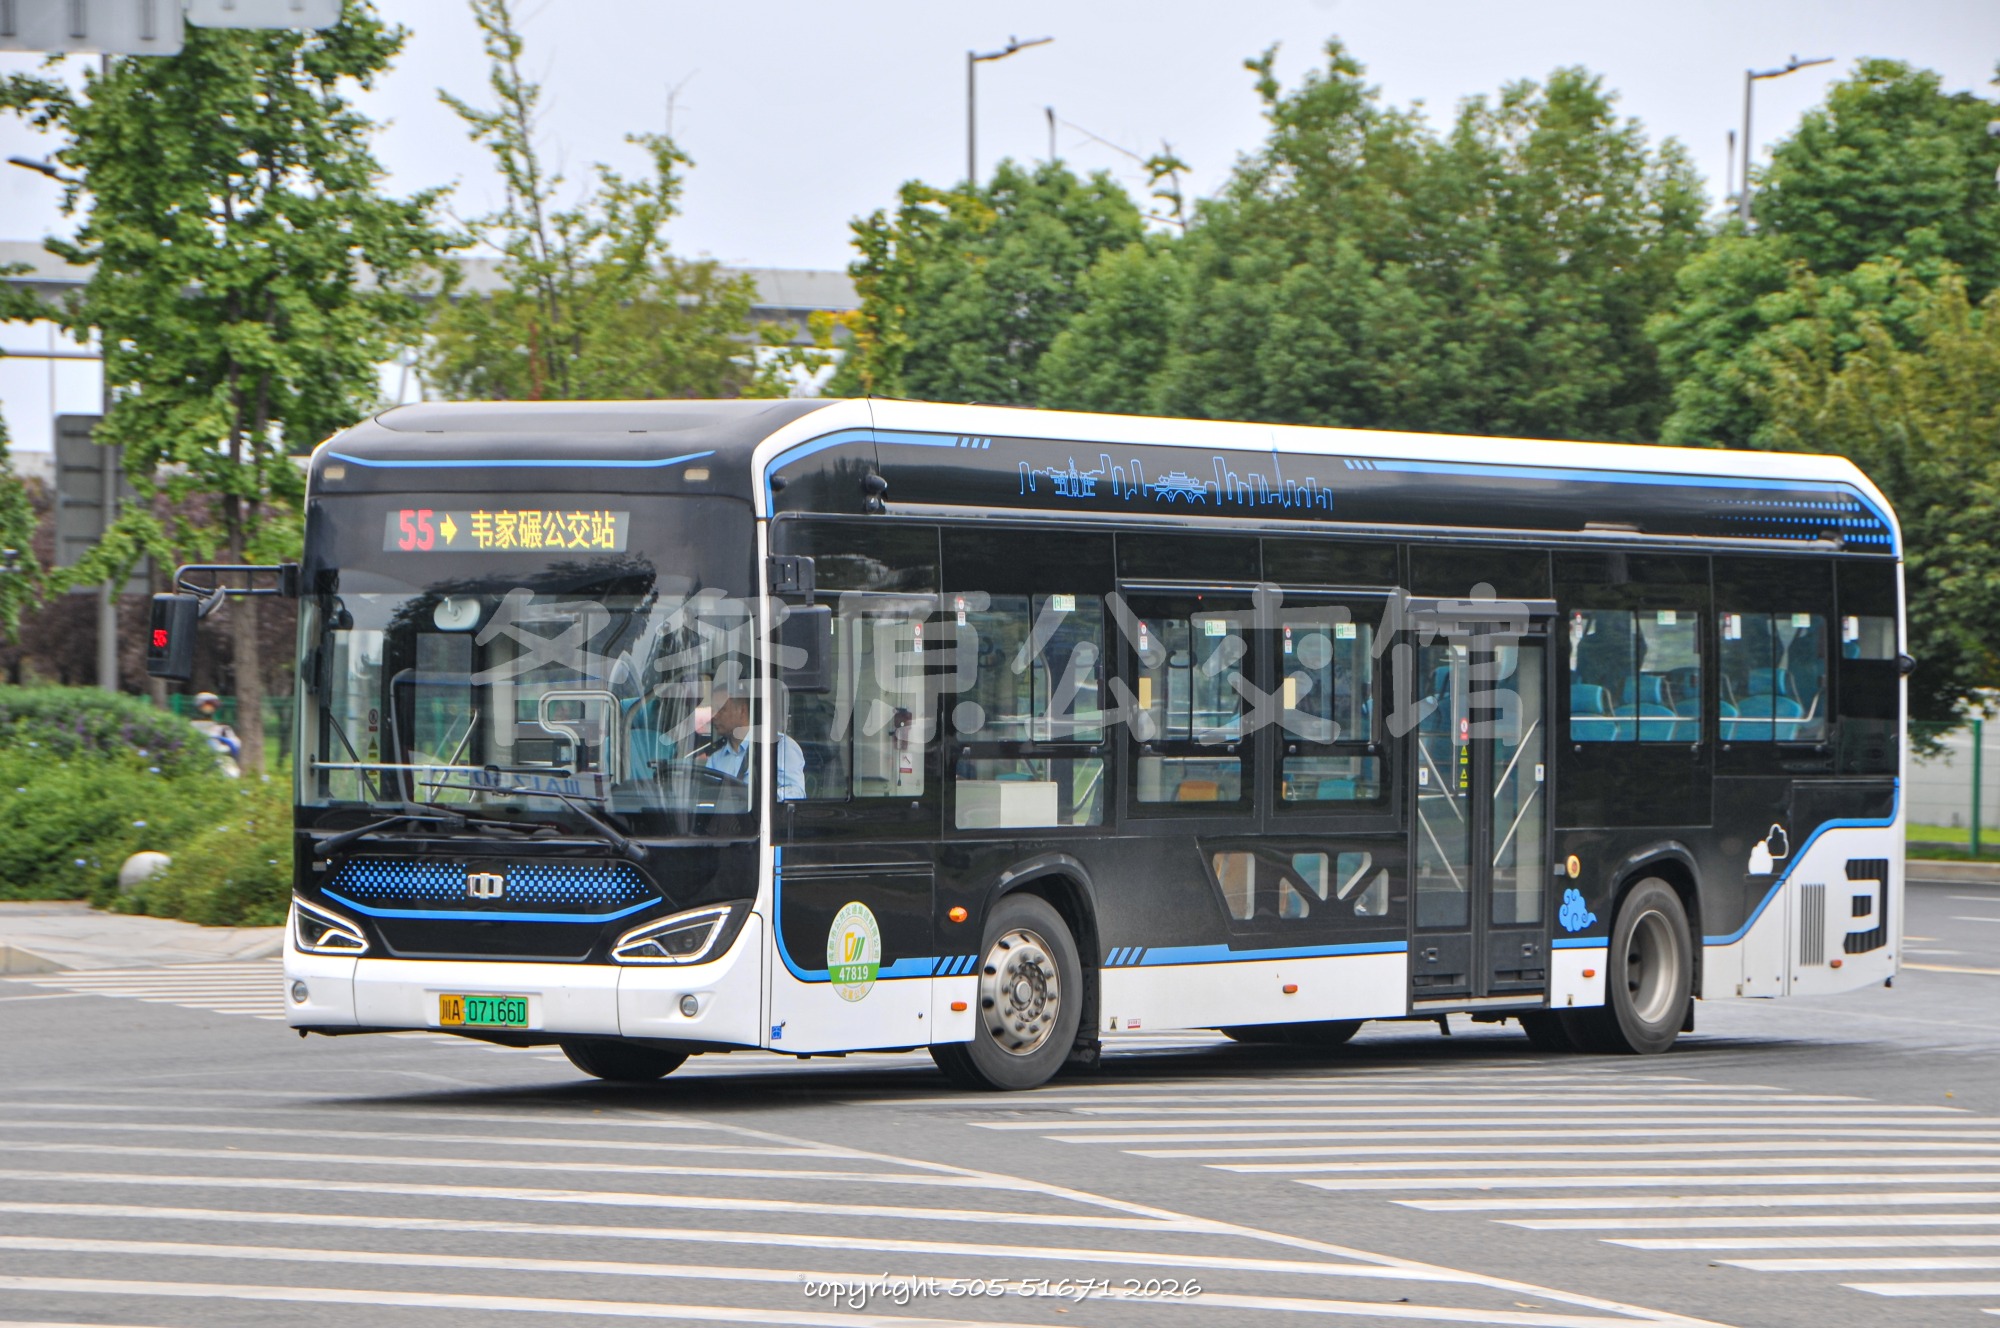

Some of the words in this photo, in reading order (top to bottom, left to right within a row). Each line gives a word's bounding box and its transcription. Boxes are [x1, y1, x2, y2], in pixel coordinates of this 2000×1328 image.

[397, 509, 435, 551] 55
[470, 510, 615, 549] 韦家碾公交站
[838, 965, 869, 982] 47819
